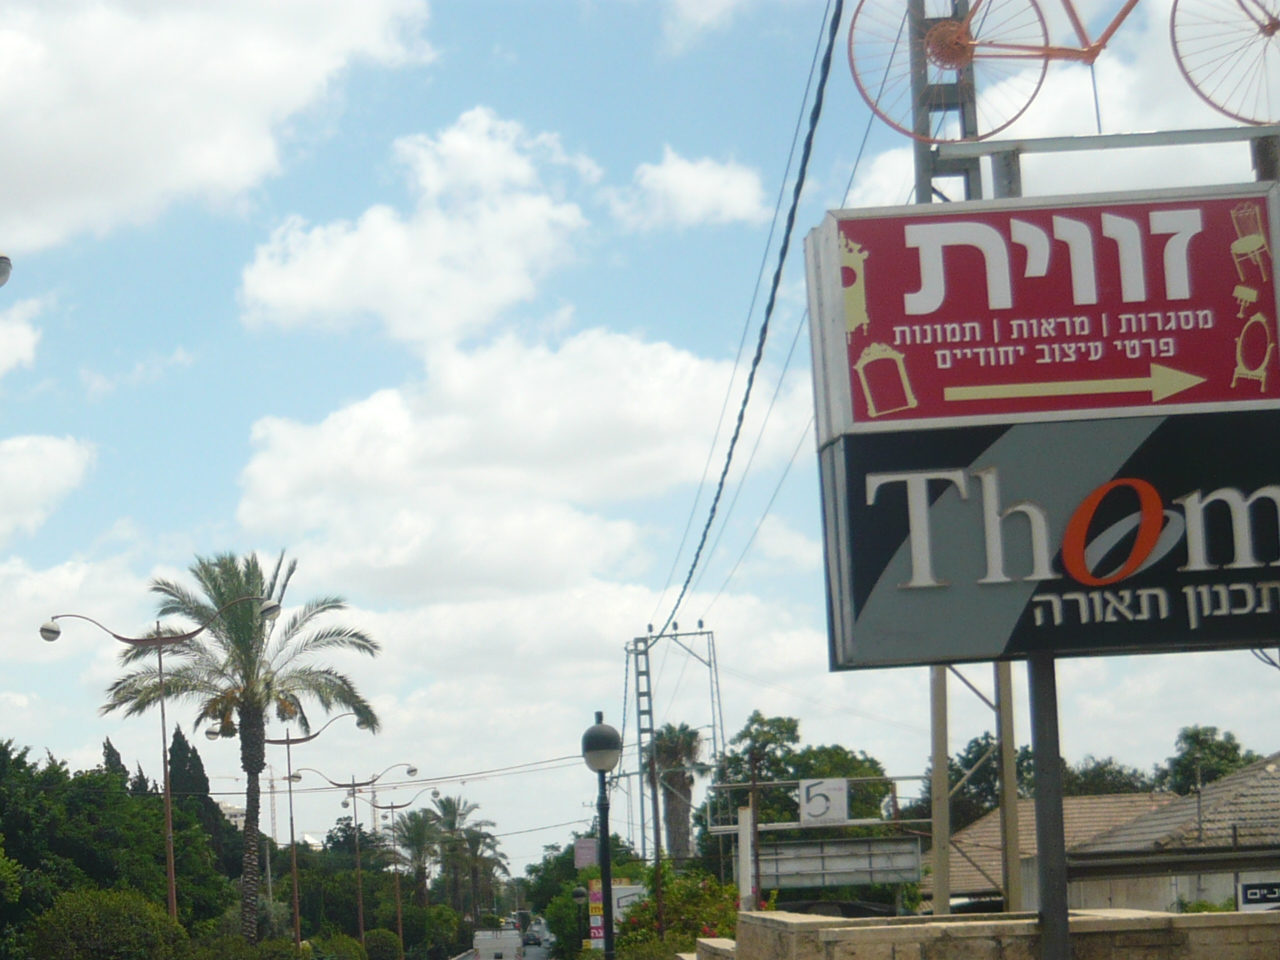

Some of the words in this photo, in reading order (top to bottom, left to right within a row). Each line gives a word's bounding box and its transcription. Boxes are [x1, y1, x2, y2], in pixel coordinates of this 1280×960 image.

[904, 208, 1204, 316] זווית
[892, 321, 982, 346] תמונות
[1009, 315, 1090, 340] מראות
[1118, 309, 1214, 334] מסגרות
[934, 345, 1025, 369] יחודיים
[1035, 341, 1104, 364] עיצוב
[1112, 337, 1176, 359] פרטי
[1032, 587, 1170, 627] תאורה
